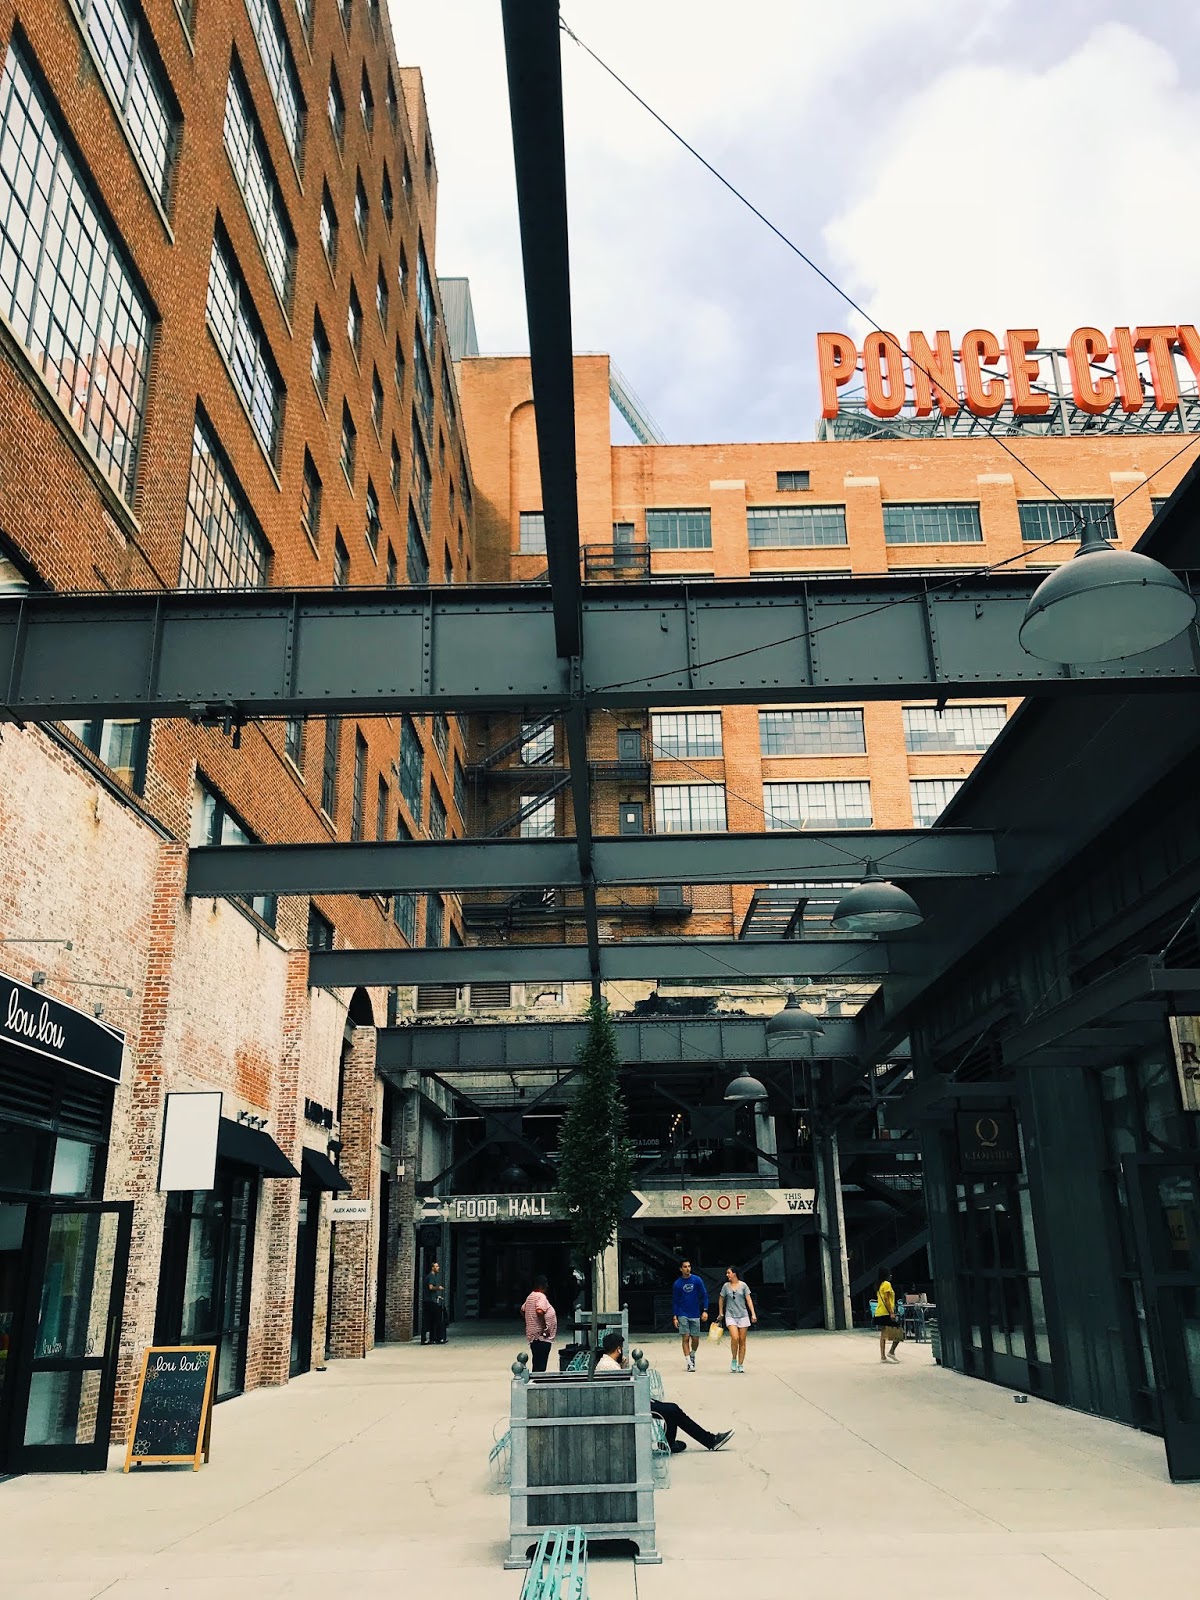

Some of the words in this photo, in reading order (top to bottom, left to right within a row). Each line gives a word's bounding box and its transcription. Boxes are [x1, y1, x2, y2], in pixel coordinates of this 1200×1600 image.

[817, 329, 1050, 418] PONCE
[4, 987, 37, 1038] lou
[36, 1001, 66, 1049] lou
[975, 1118, 999, 1147] Q
[456, 1200, 497, 1218] FOOD
[508, 1197, 551, 1217] HALL
[681, 1195, 747, 1211] ROOF
[787, 1200, 814, 1210] WAY
[154, 1355, 177, 1372] lou
[178, 1355, 201, 1372] lou
